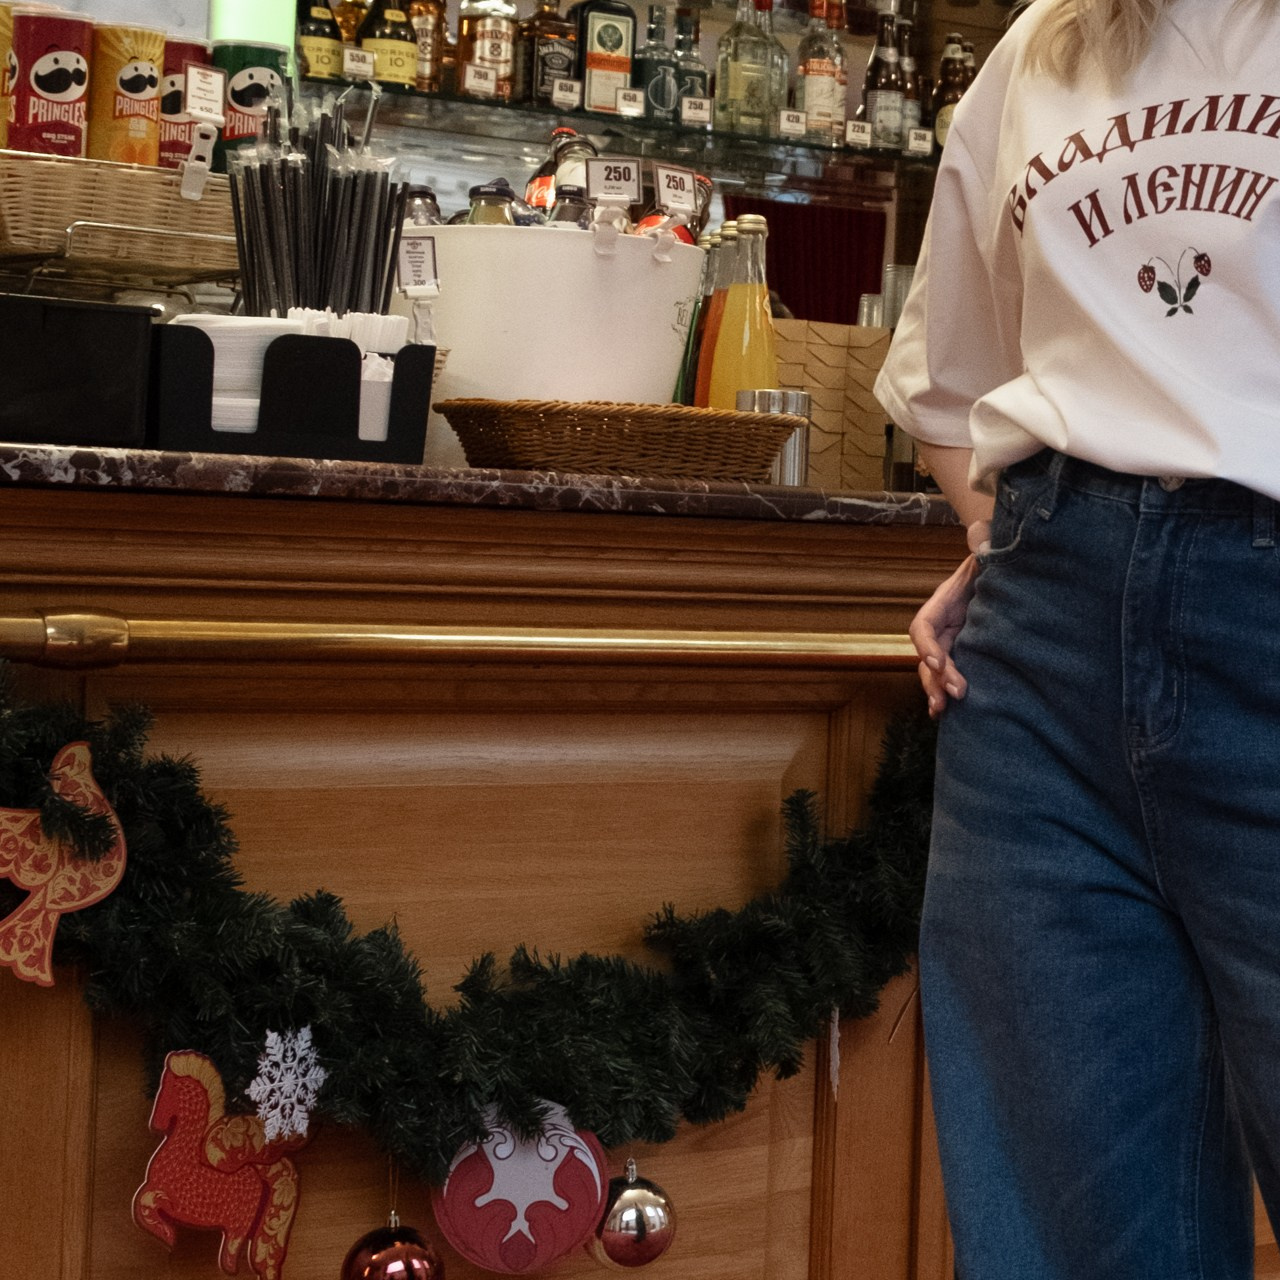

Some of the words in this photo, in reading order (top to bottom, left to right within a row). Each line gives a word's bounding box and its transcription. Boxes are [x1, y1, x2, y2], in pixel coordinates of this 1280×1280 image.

[28, 96, 87, 127] PRINGLES
[115, 95, 159, 121] PRINGLES
[604, 165, 631, 182] 250
[665, 174, 685, 192] 250
[1067, 188, 1115, 248] И
